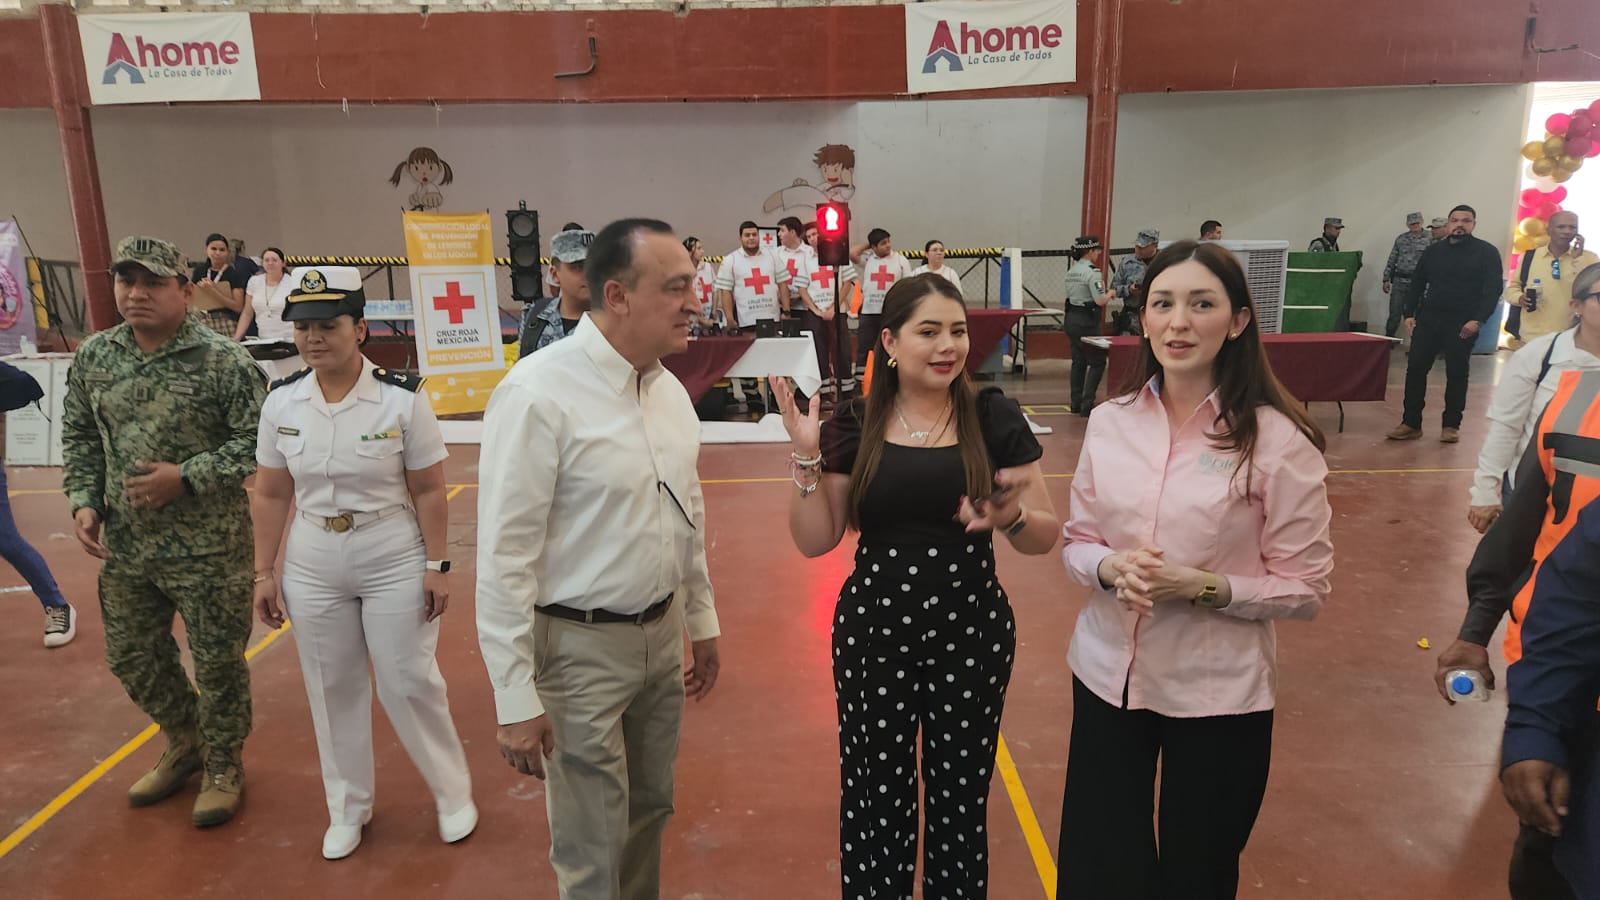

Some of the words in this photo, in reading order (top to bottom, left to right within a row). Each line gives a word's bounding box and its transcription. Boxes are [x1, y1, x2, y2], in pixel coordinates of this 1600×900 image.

[926, 20, 1063, 56] Ahome
[105, 32, 240, 67] Ahome
[968, 55, 980, 65] La
[983, 54, 1006, 64] Casa
[1009, 52, 1021, 62] de
[1024, 50, 1053, 61] Todos
[148, 68, 160, 78] La
[163, 68, 187, 78] Casa
[190, 67, 202, 77] de
[205, 66, 233, 76] Todos
[436, 329, 457, 338] CRUZ
[458, 328, 479, 336] ROJA
[436, 335, 480, 345] MEXICANA
[430, 350, 490, 362] PREVENCIÓN
